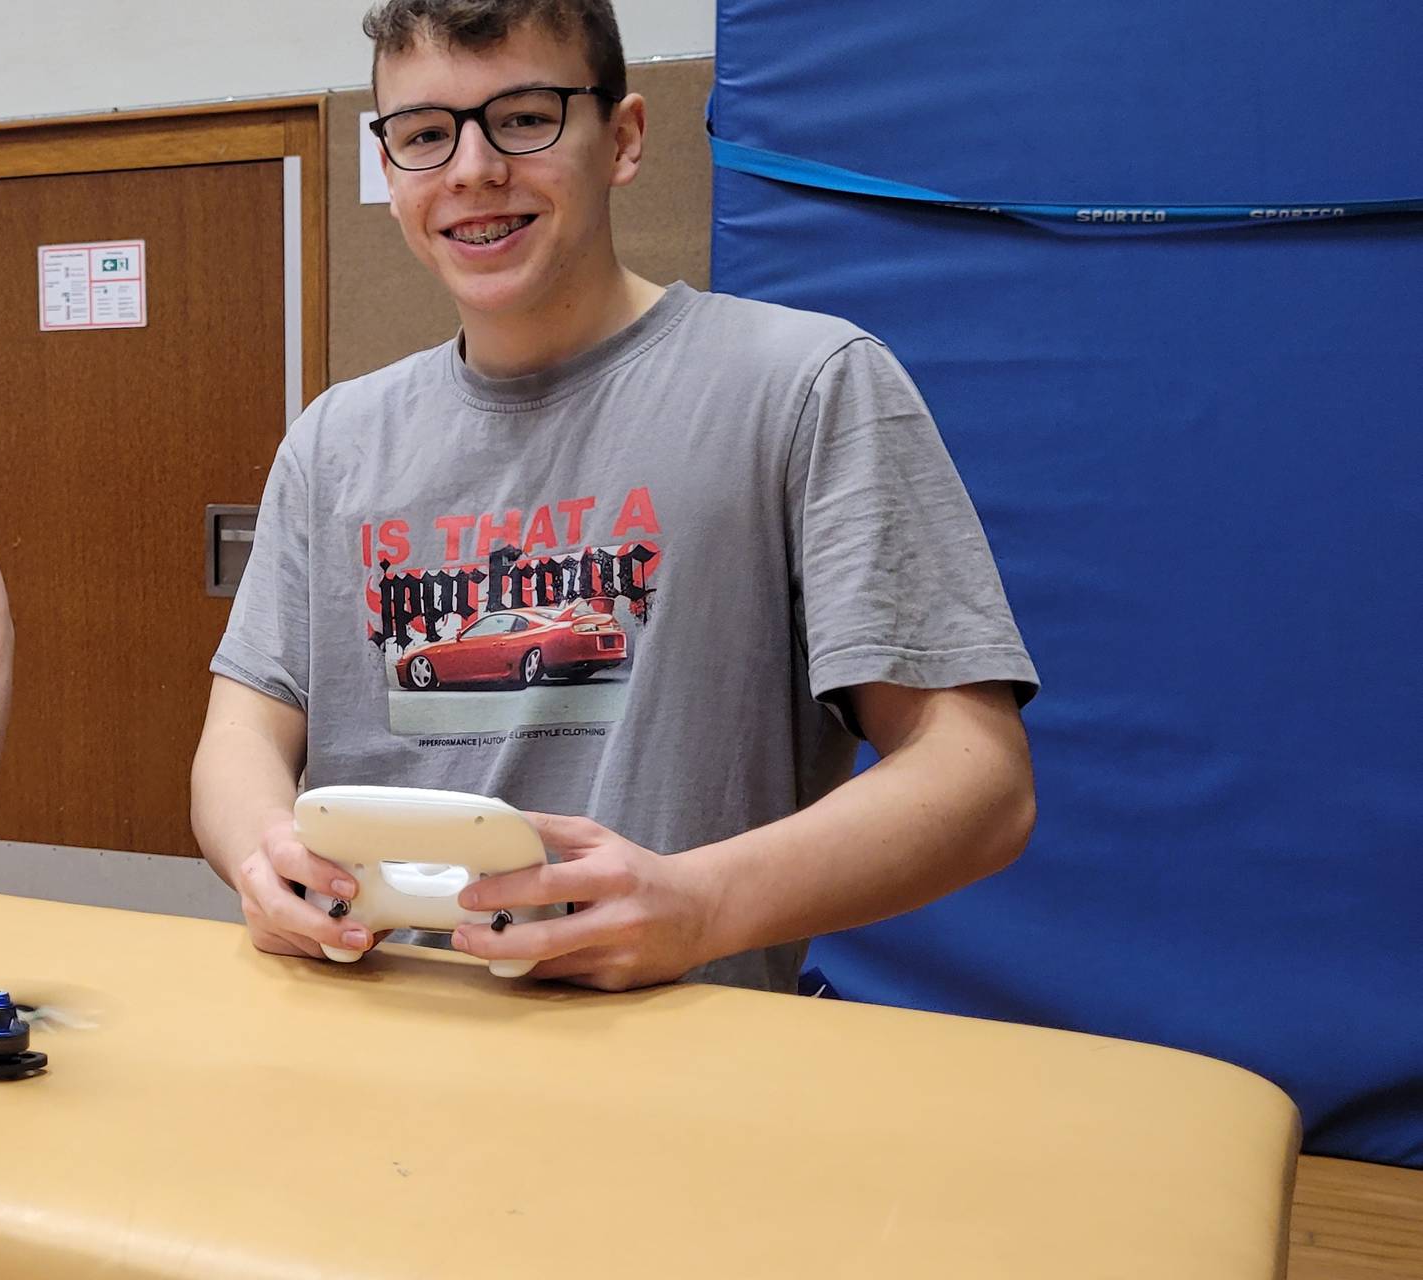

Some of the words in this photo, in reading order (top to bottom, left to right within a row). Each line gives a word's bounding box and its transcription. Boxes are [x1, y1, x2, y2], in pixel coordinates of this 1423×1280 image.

[1076, 209, 1167, 223] SPORTCO
[360, 519, 411, 569] IS
[435, 496, 595, 562] THAT
[611, 487, 660, 536] A
[515, 728, 561, 739] LIFESTYLE
[562, 727, 606, 736] CLOTHING
